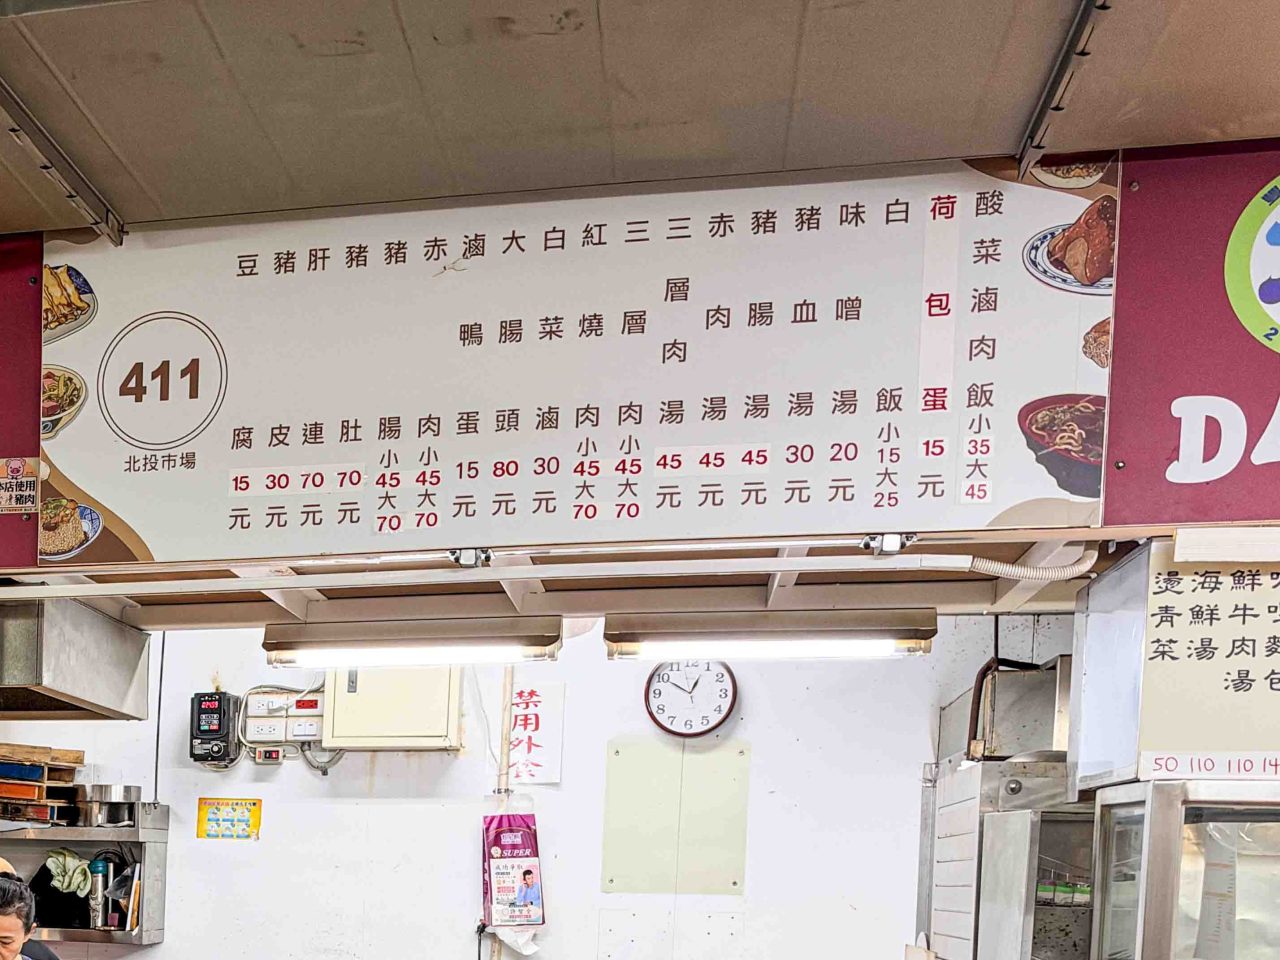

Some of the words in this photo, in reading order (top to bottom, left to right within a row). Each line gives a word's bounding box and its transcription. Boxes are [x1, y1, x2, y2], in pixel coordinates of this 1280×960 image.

[117, 357, 202, 404] 411
[122, 450, 198, 475] 北投市場
[669, 661, 681, 672] 11
[704, 661, 712, 672] 1
[656, 672, 670, 683] 10
[715, 672, 725, 683] 2
[652, 688, 662, 699] 9
[718, 688, 728, 699] 3
[656, 704, 666, 715] 8
[713, 704, 723, 715] 4
[667, 716, 677, 726] 7
[684, 719, 693, 730] 6
[700, 716, 710, 726] 5
[1153, 756, 1179, 773] 50
[1189, 757, 1215, 774] 110
[1227, 758, 1254, 774] 110
[501, 848, 532, 857] SUPER
